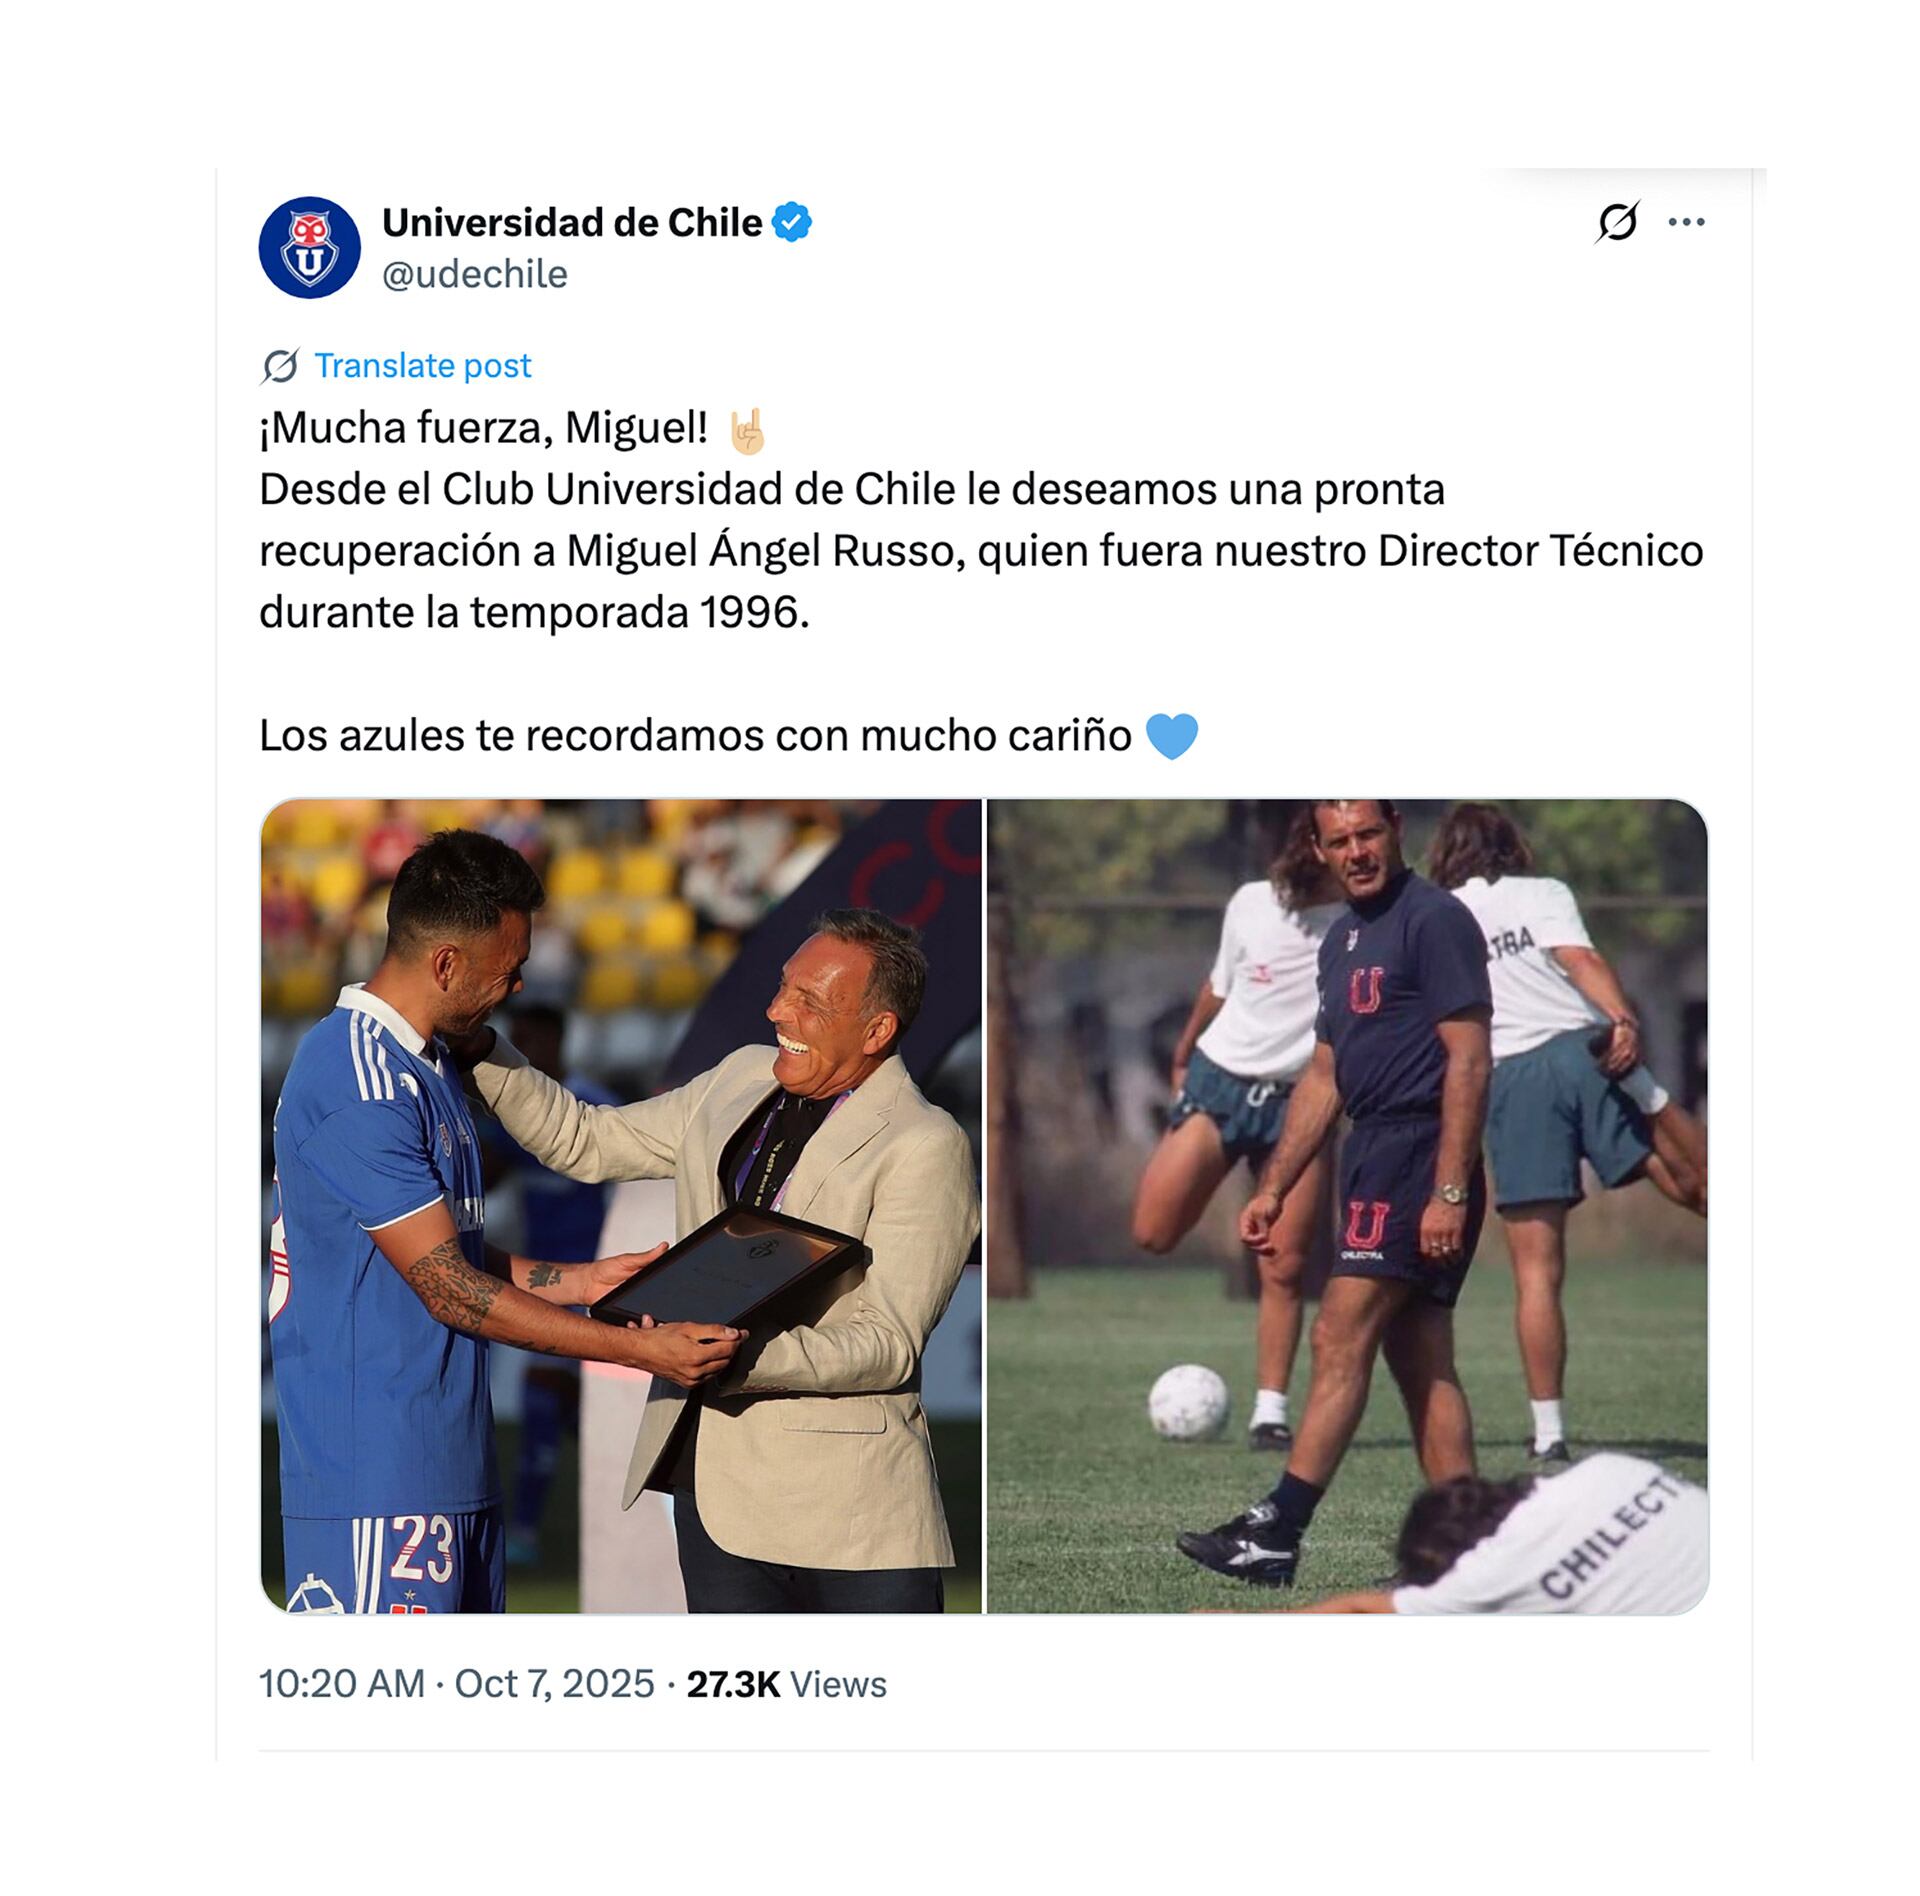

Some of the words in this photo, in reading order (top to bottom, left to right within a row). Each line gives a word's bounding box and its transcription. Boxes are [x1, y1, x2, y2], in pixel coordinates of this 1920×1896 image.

[383, 205, 604, 238] Universidad
[613, 205, 660, 238] de
[668, 205, 764, 238] Chile
[382, 257, 568, 292] @udechile
[314, 351, 456, 378] Translate
[464, 353, 533, 385] post
[260, 408, 406, 453] ¡Mucha
[416, 408, 553, 450] fuerza,
[567, 408, 707, 453] Miguel!
[261, 469, 387, 506] Desde
[397, 469, 430, 506] el
[443, 469, 534, 506] Club
[547, 469, 782, 506] Universidad
[794, 469, 844, 506] de
[855, 469, 956, 506] Chile
[968, 469, 1001, 506] le
[1012, 469, 1218, 506] deseamos
[1230, 479, 1302, 506] una
[1315, 473, 1445, 514] pronta
[261, 531, 520, 576] recuperación
[533, 540, 556, 567] a
[568, 531, 697, 576] Miguel
[708, 526, 820, 576] Ángel
[834, 533, 966, 573] Russo,
[978, 531, 1088, 576] quien
[1098, 531, 1203, 568] fuera
[1215, 534, 1367, 568] nuestro
[1380, 531, 1540, 568] Director
[1549, 531, 1704, 568] Técnico
[259, 593, 415, 629] durante
[427, 593, 459, 629] la
[469, 593, 689, 637] temporada
[700, 594, 809, 629] 1996.
[261, 718, 328, 752] Los
[339, 716, 465, 752] azules
[475, 719, 515, 752] te
[527, 716, 765, 752] recordamos
[776, 725, 848, 752] con
[862, 716, 997, 752] mucho
[1008, 716, 1132, 752] cariño
[1487, 925, 1536, 962] TRA
[1346, 1201, 1390, 1249] U
[390, 1514, 454, 1584] 23
[259, 1668, 357, 1699] 10:20
[367, 1668, 424, 1698] AM
[455, 1668, 519, 1699] Oct
[527, 1668, 552, 1703] 7,
[563, 1668, 655, 1699] 2025
[687, 1669, 782, 1699] 27.3K
[789, 1669, 888, 1698] Views
